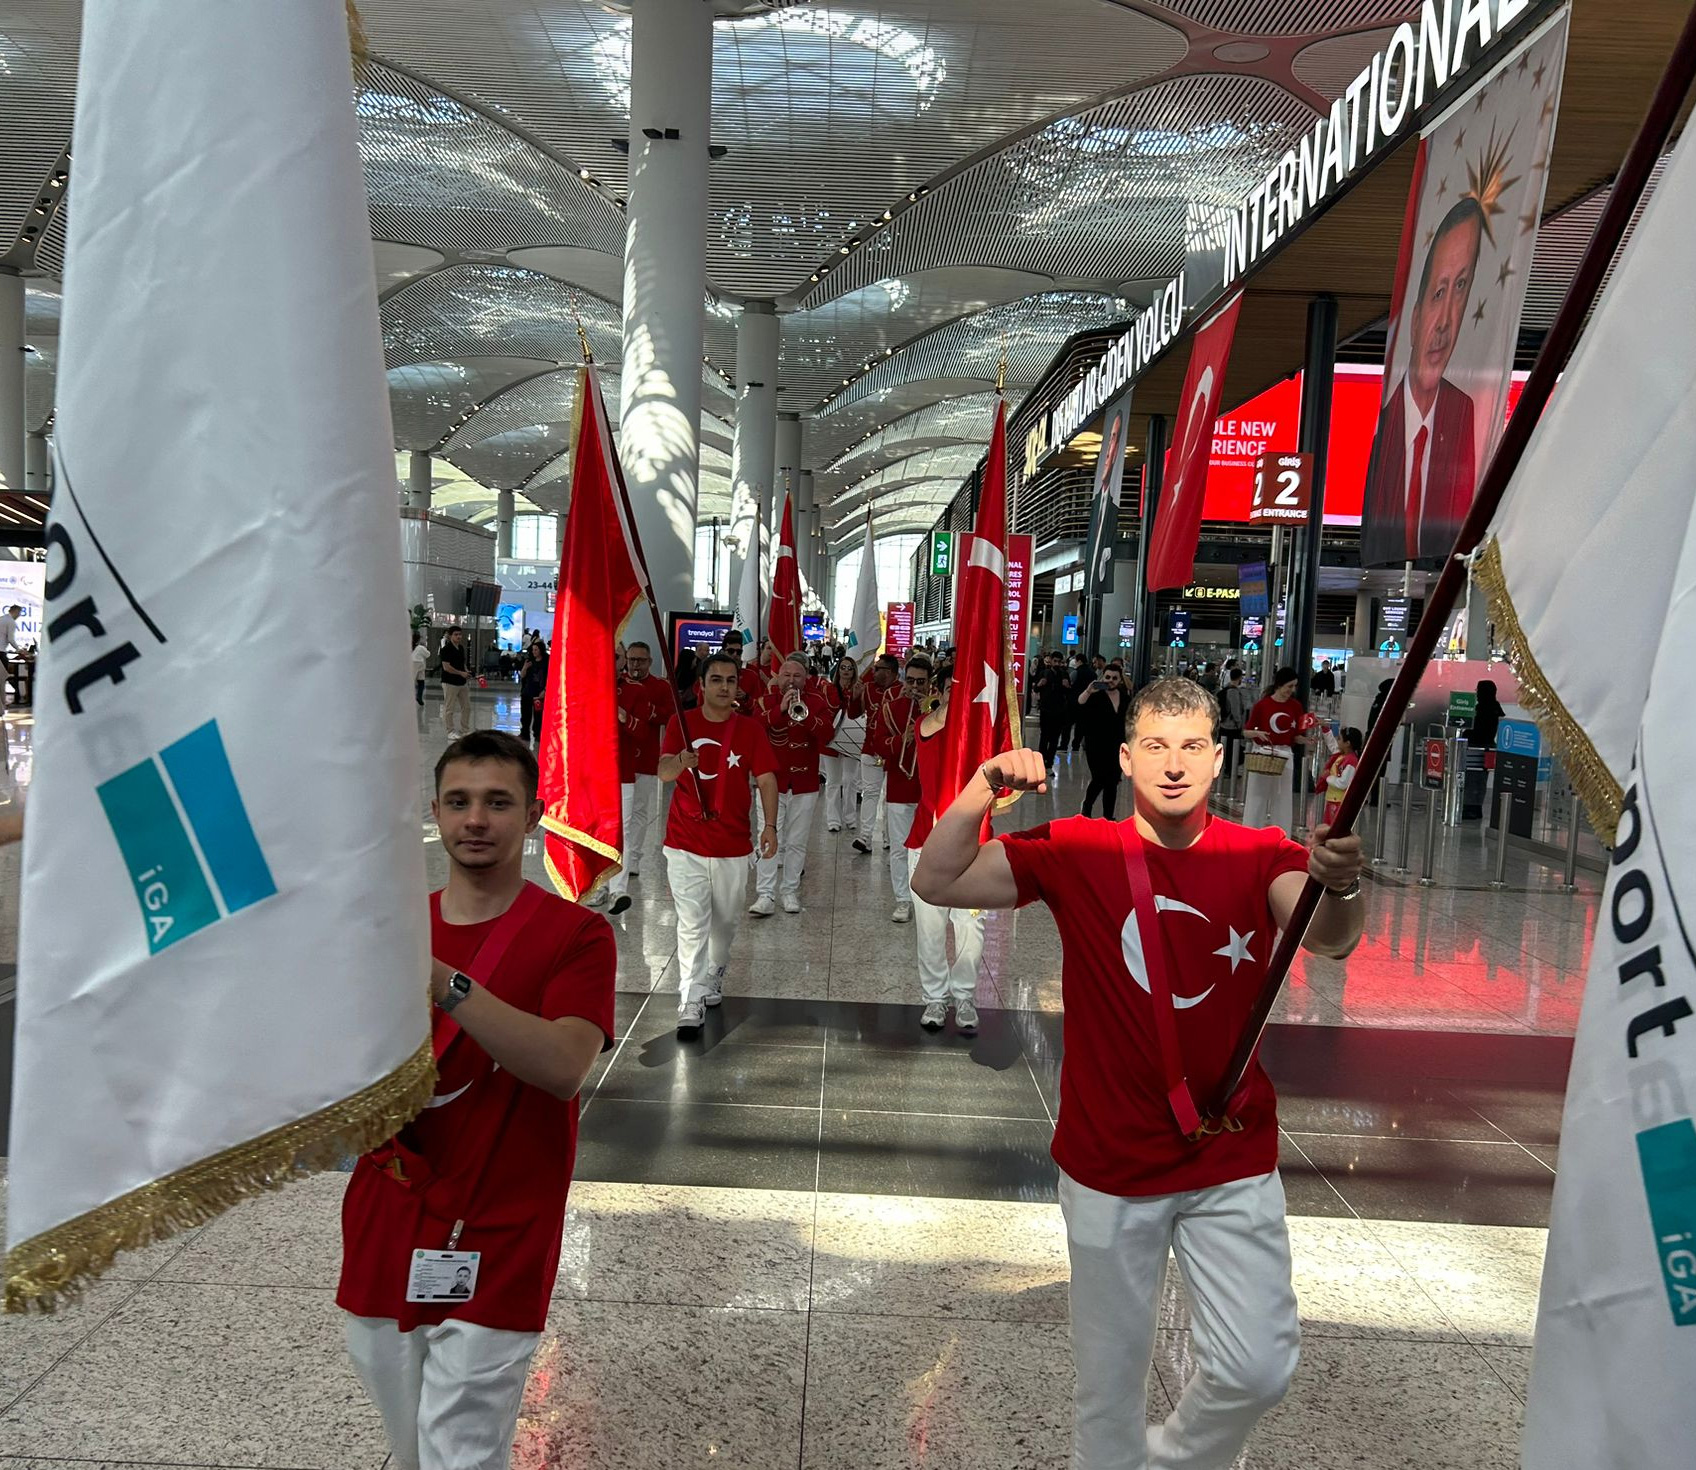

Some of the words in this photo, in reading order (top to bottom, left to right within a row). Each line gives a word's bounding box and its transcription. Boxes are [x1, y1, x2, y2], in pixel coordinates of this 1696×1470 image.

[1097, 325, 1135, 405] GİDEN
[1135, 270, 1185, 371] YOLCU
[1240, 421, 1277, 437] NEW
[1274, 470, 1301, 506] 2
[1262, 508, 1308, 519] ENTRANCE
[527, 580, 554, 589] 23-44
[687, 629, 715, 638] trendyol
